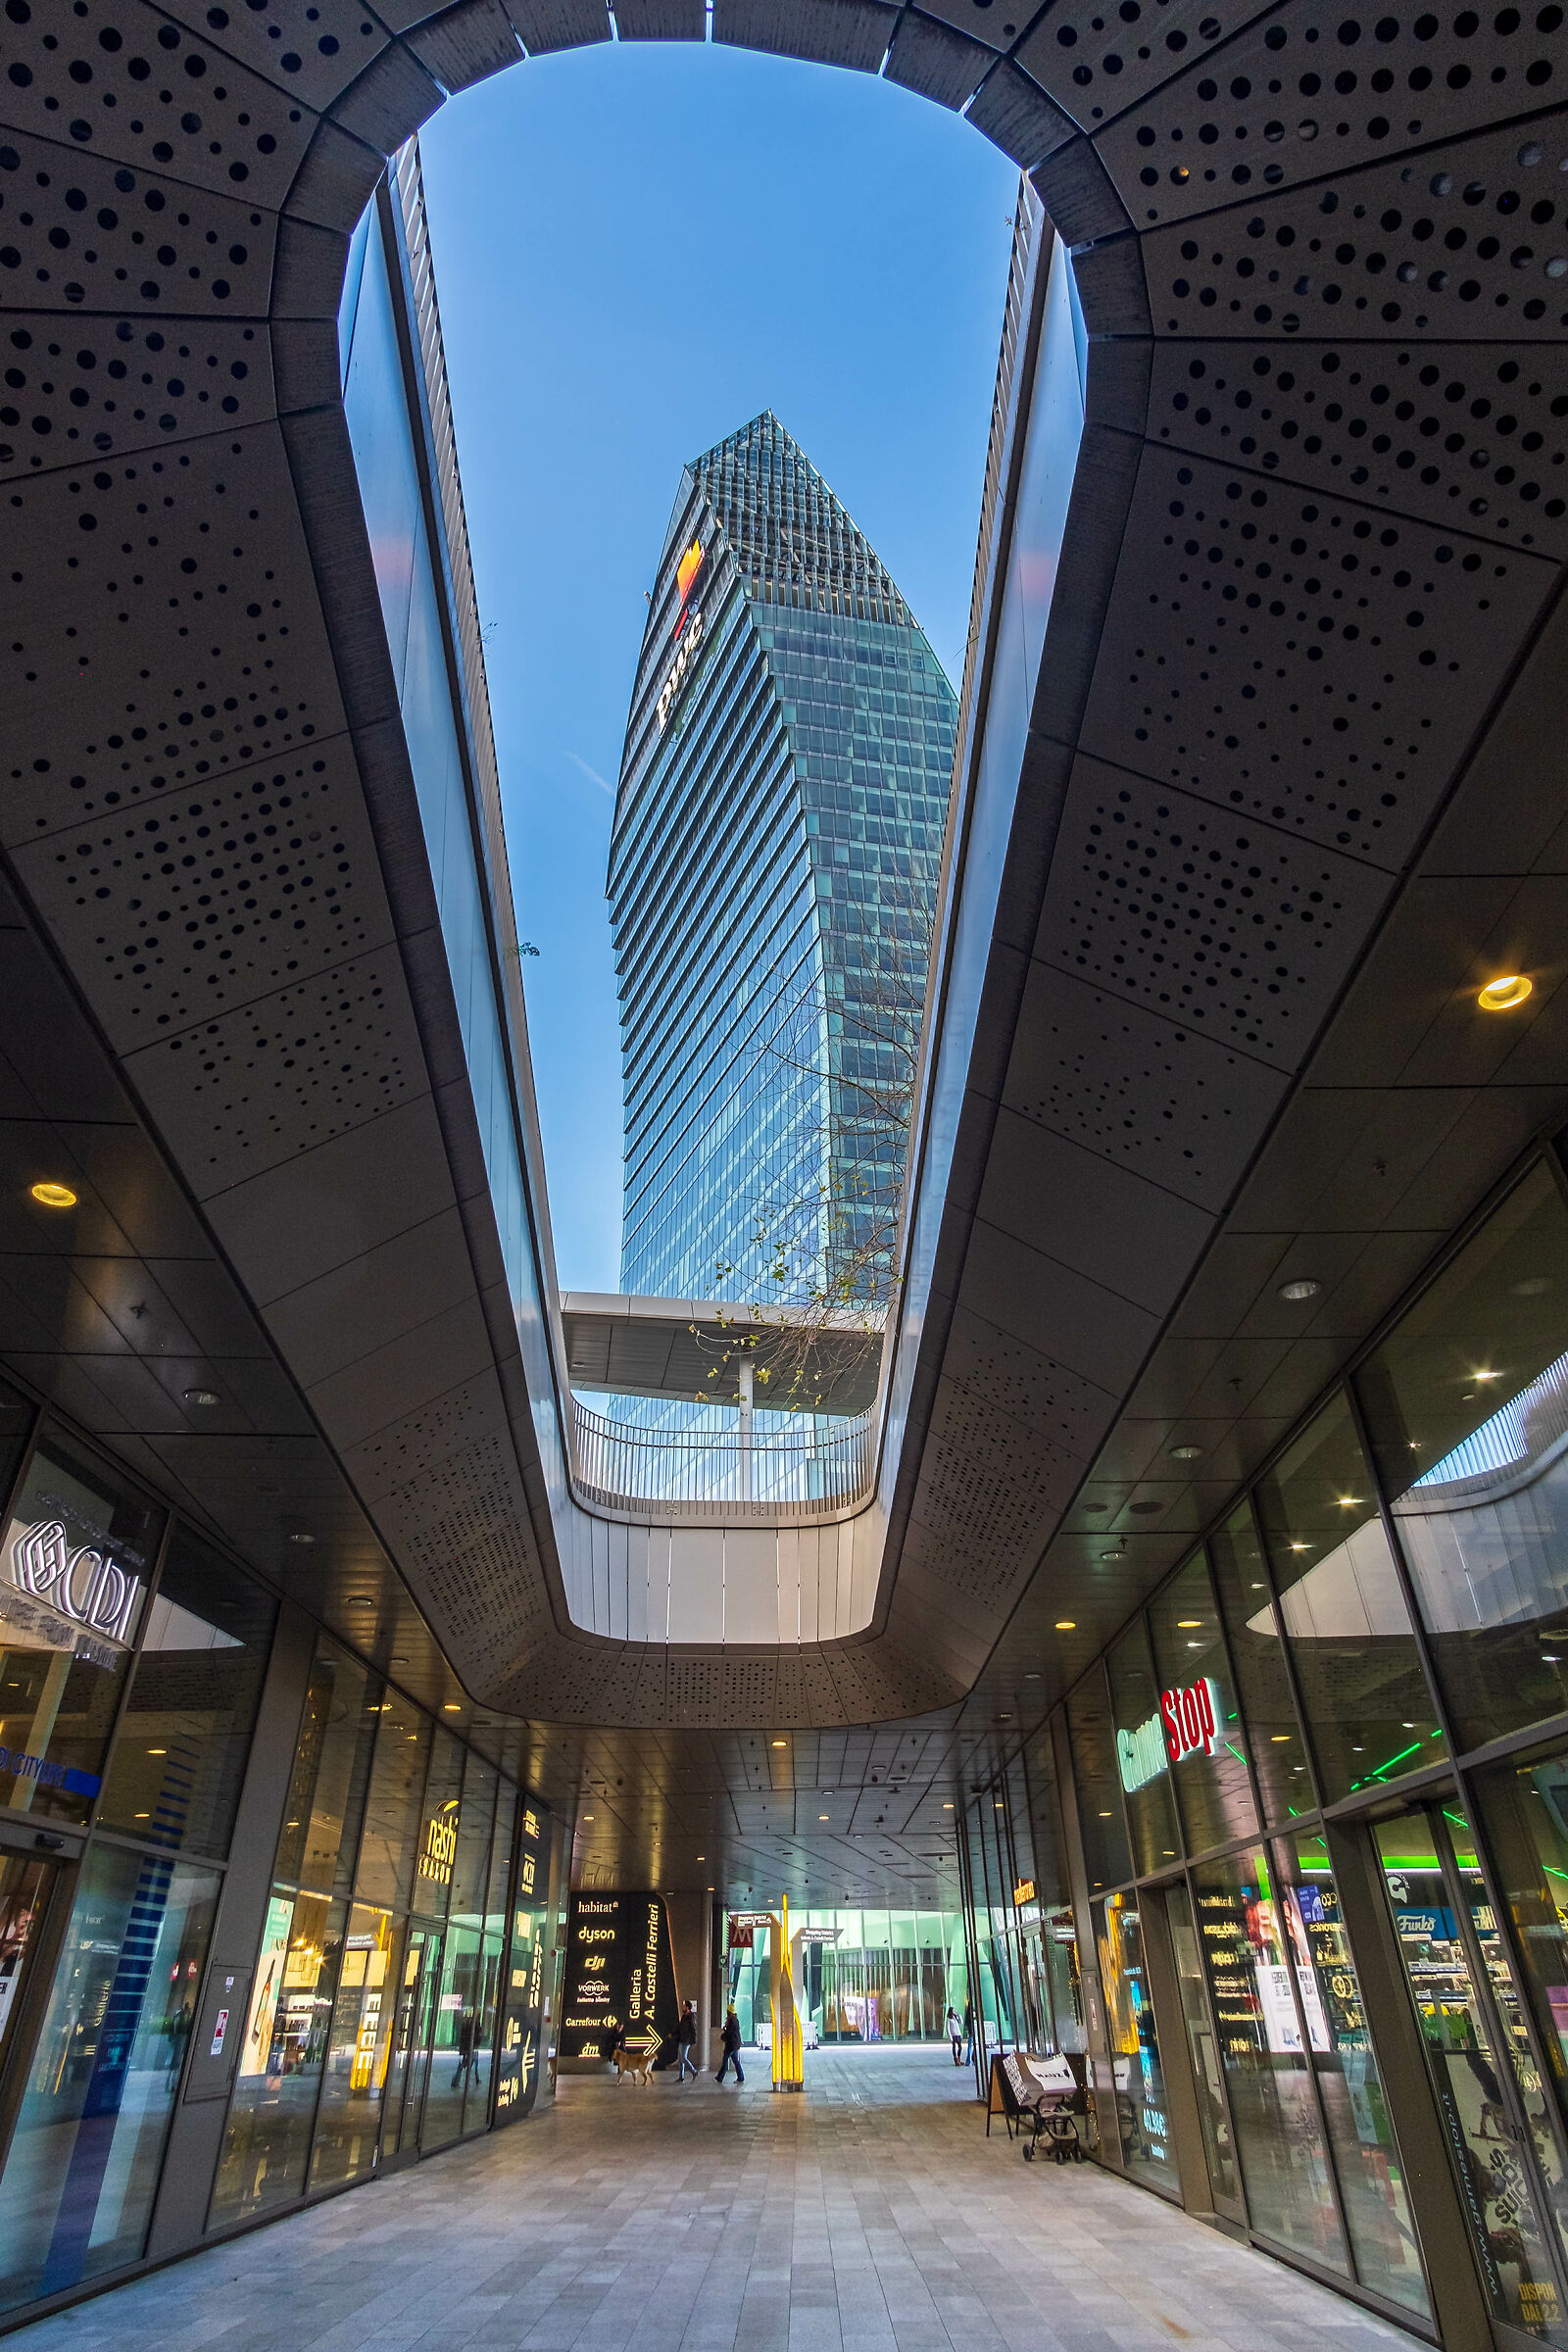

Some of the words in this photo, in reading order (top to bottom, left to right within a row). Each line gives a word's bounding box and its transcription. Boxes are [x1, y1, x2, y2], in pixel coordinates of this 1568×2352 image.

[62, 1544, 140, 1642] CDI
[426, 1815, 459, 1866] nashi
[578, 1901, 612, 1913] habitat
[578, 1926, 615, 1943] dyson
[647, 1903, 660, 1951] Ferrieri
[1397, 1915, 1436, 1932] Funko
[644, 1952, 658, 2001] Castelli
[629, 1968, 642, 2020] Galleria
[565, 2017, 601, 2027] Carrefour
[644, 2005, 656, 2020] A.
[582, 2042, 600, 2055] dm
[1441, 2092, 1498, 2295] www.gamestop.it
